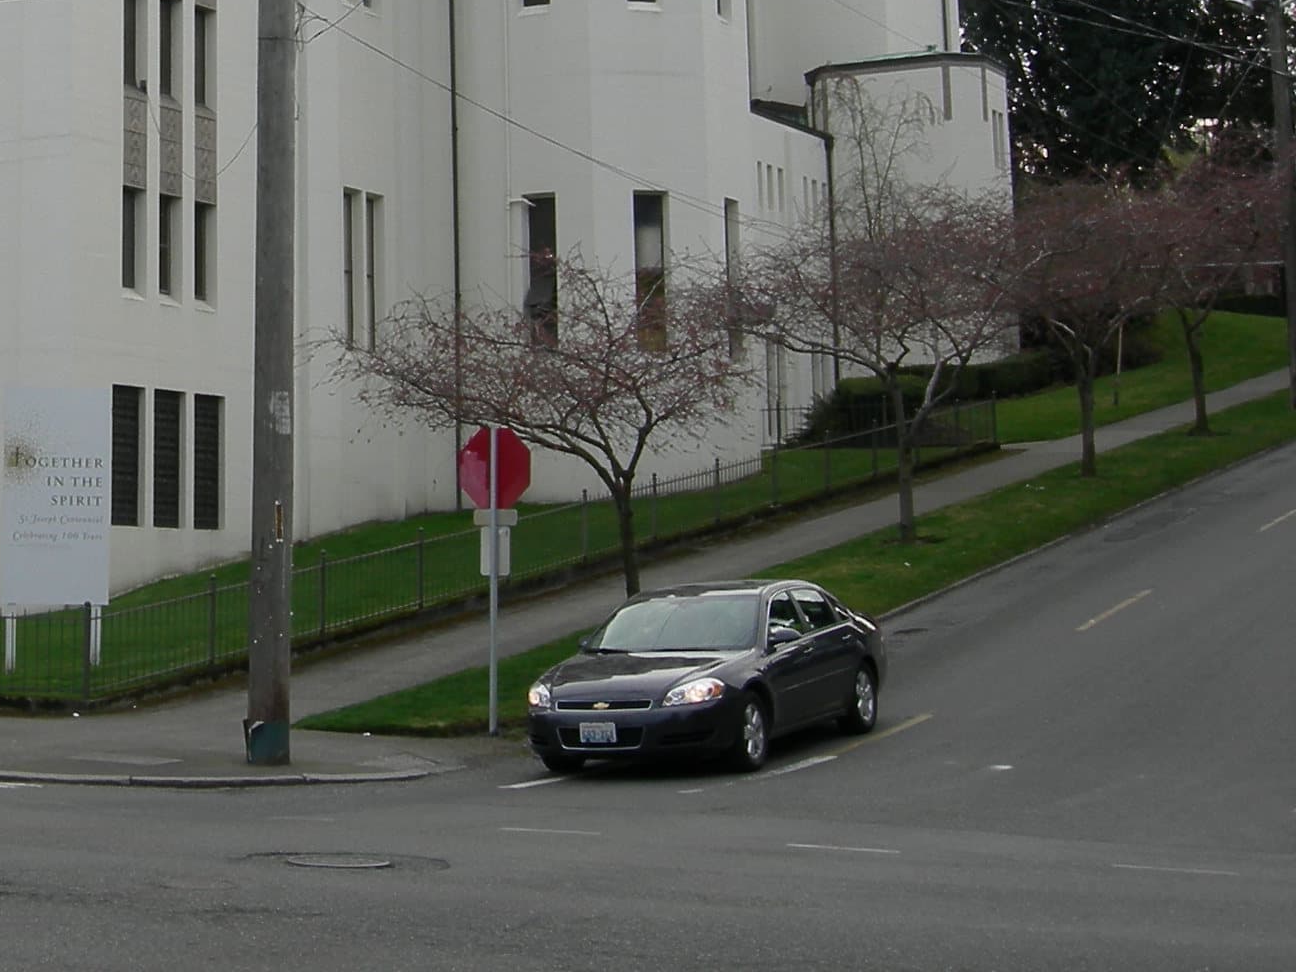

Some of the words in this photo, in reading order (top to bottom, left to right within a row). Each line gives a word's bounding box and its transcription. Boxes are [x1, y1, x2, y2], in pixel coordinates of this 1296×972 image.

[47, 476, 64, 487] IN
[70, 476, 103, 488] THE
[50, 495, 103, 506] SPIRIT
[12, 531, 58, 542] Celebrating
[62, 532, 80, 540] 100
